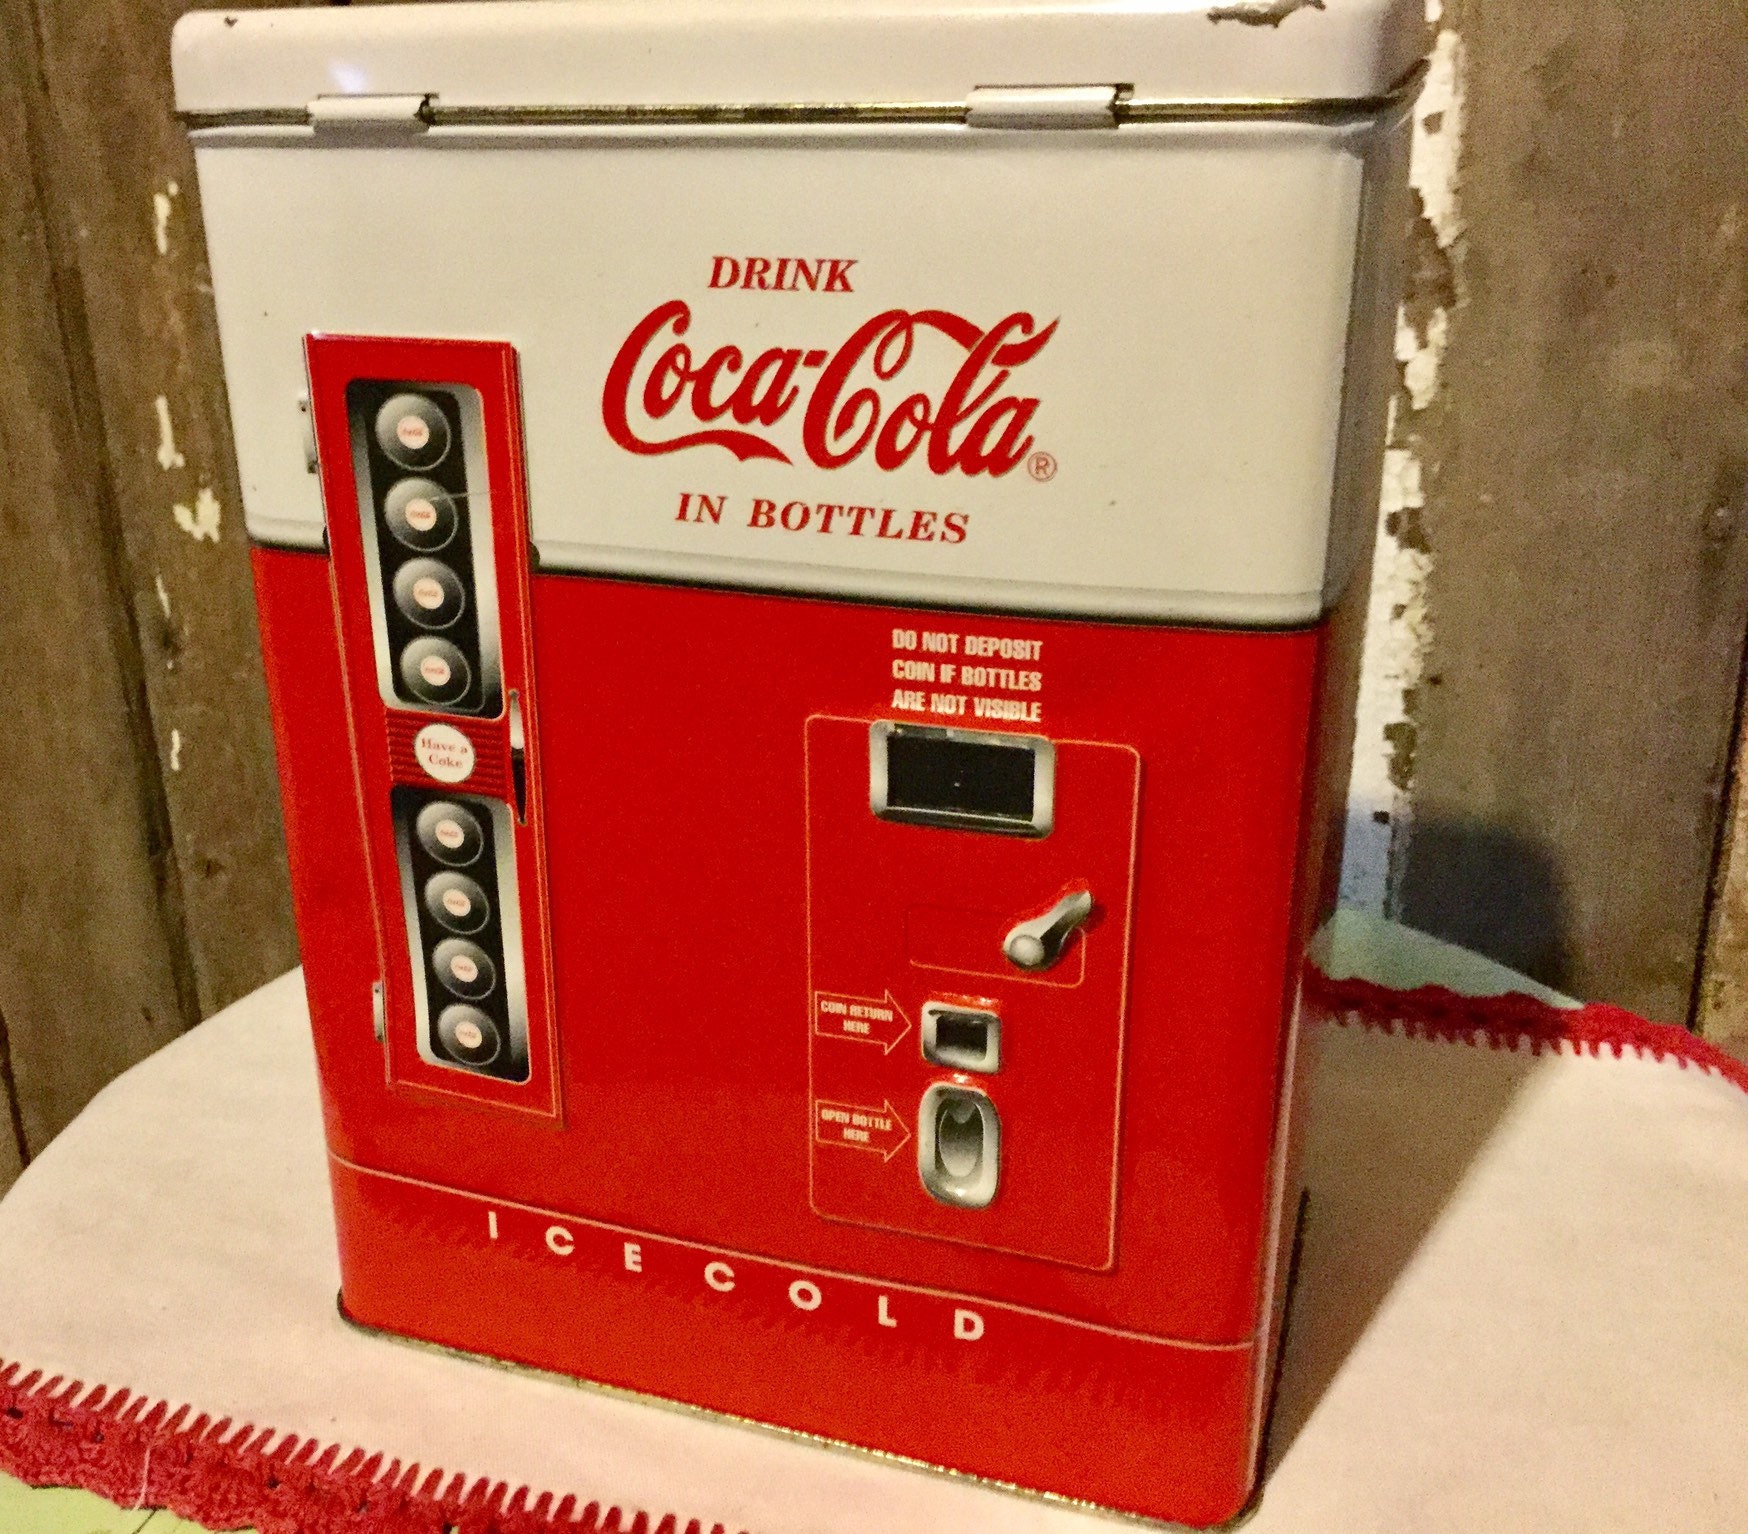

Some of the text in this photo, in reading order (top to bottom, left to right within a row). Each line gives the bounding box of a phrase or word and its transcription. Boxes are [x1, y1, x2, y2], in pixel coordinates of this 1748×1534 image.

[708, 256, 858, 293] DRINK
[602, 300, 1060, 477] Coca-Cola
[675, 493, 970, 544] IN BOTTLES
[892, 628, 1043, 661] DO NOT DEPOSIT
[892, 659, 1042, 691] COIN IF BOTTLES
[891, 689, 1042, 722] ARE NOT VISIBLE
[421, 738, 456, 752] Have
[428, 754, 463, 768] Coke
[820, 1000, 894, 1023] COIN RETURN
[821, 1109, 893, 1132] OPEN BOTTLE
